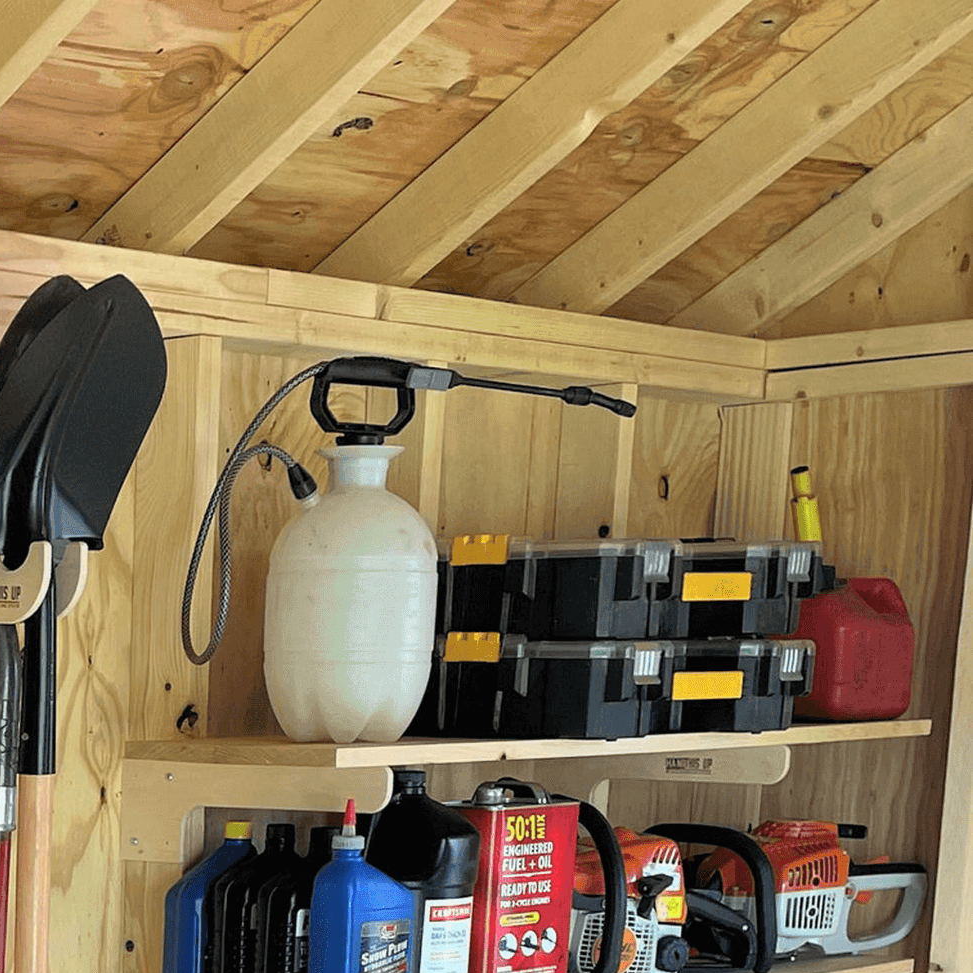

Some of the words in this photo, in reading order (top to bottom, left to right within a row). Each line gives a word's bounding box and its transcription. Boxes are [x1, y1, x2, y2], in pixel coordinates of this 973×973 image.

[505, 815, 536, 842] 50:1
[537, 814, 546, 839] MIX
[503, 841, 553, 857] ENGINEERED
[502, 857, 526, 872] FUEL
[528, 859, 537, 870] +
[538, 855, 552, 869] OIL
[500, 883, 527, 897] READY
[528, 881, 538, 894] TO
[538, 879, 551, 893] USE
